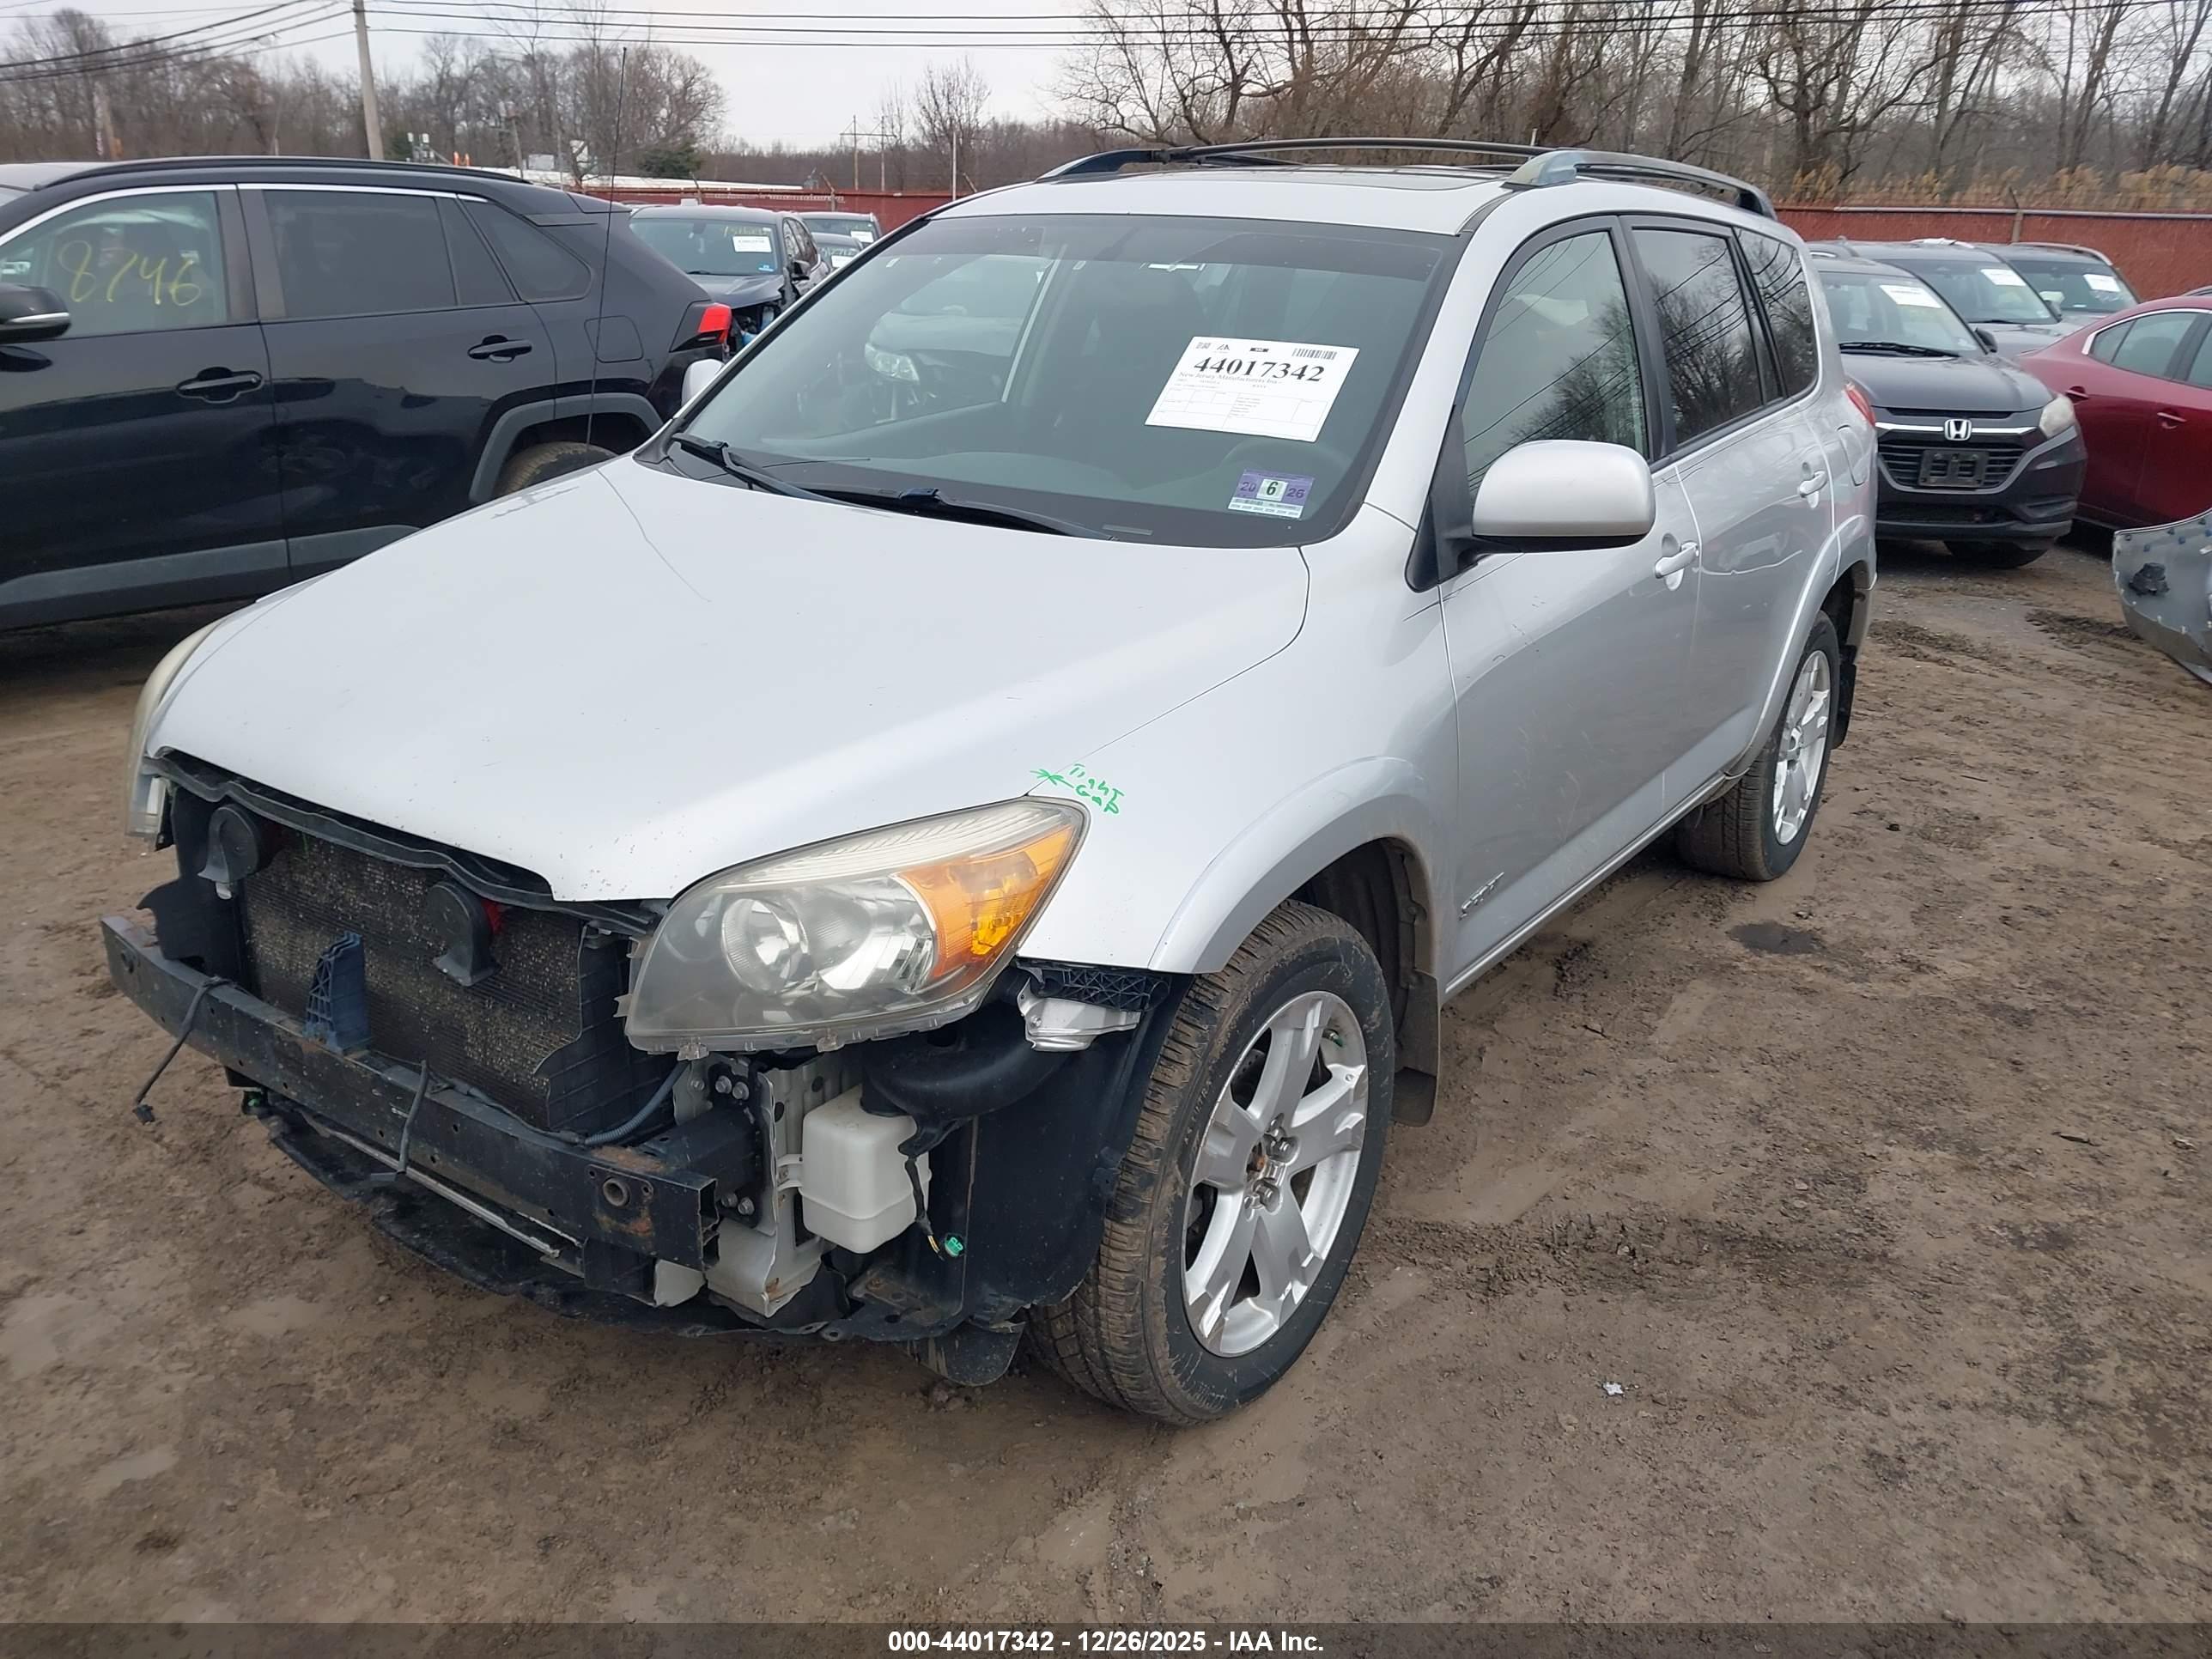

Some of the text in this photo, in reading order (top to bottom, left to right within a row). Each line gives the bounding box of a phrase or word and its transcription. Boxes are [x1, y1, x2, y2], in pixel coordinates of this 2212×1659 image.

[58, 240, 201, 307] 8746
[1194, 356, 1325, 382] 44017342
[1240, 481, 1306, 499] 20 6 26
